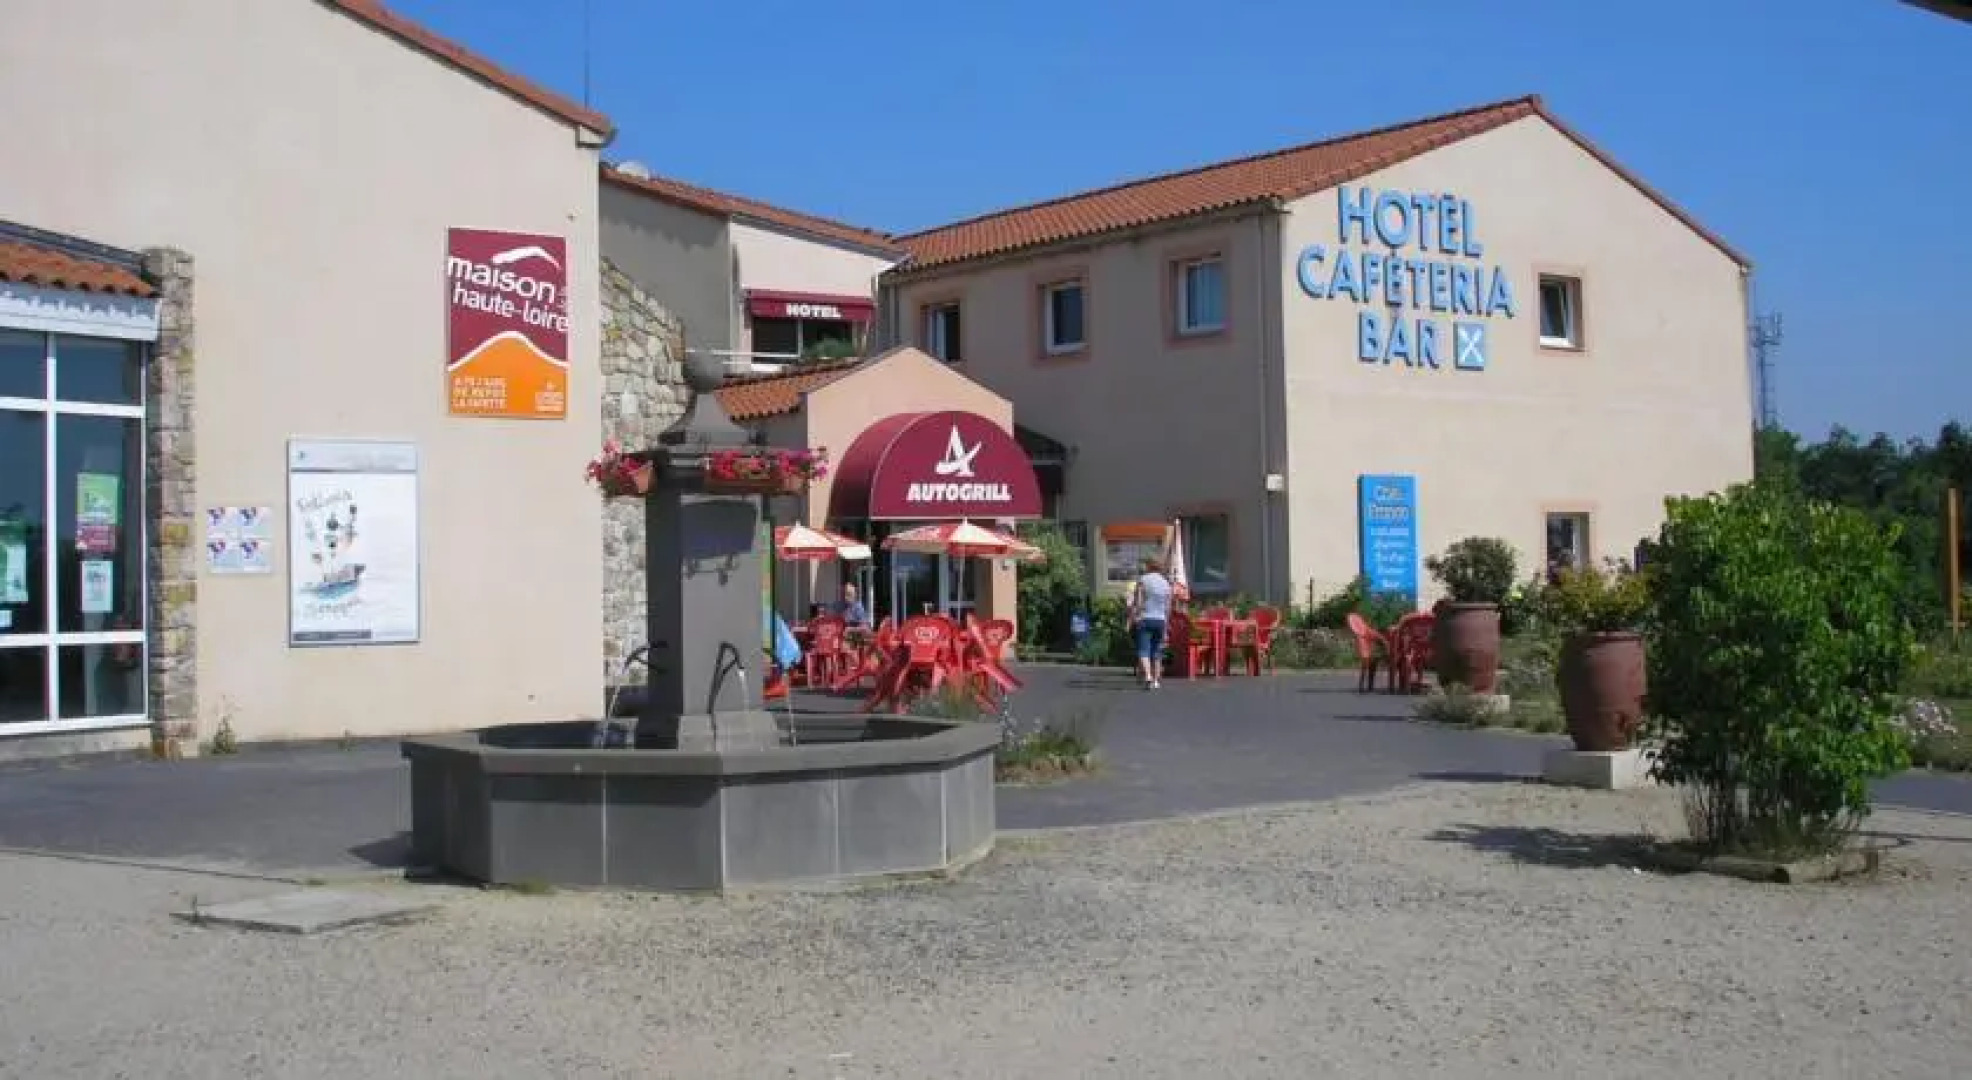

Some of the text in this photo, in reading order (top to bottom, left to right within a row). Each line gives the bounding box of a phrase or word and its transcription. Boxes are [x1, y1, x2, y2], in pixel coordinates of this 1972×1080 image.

[447, 255, 556, 304] maison
[453, 282, 569, 332] haute-loire
[785, 302, 842, 318] HOTEL
[1358, 310, 1441, 369] BAR
[905, 482, 1013, 501] AUTOGRILL
